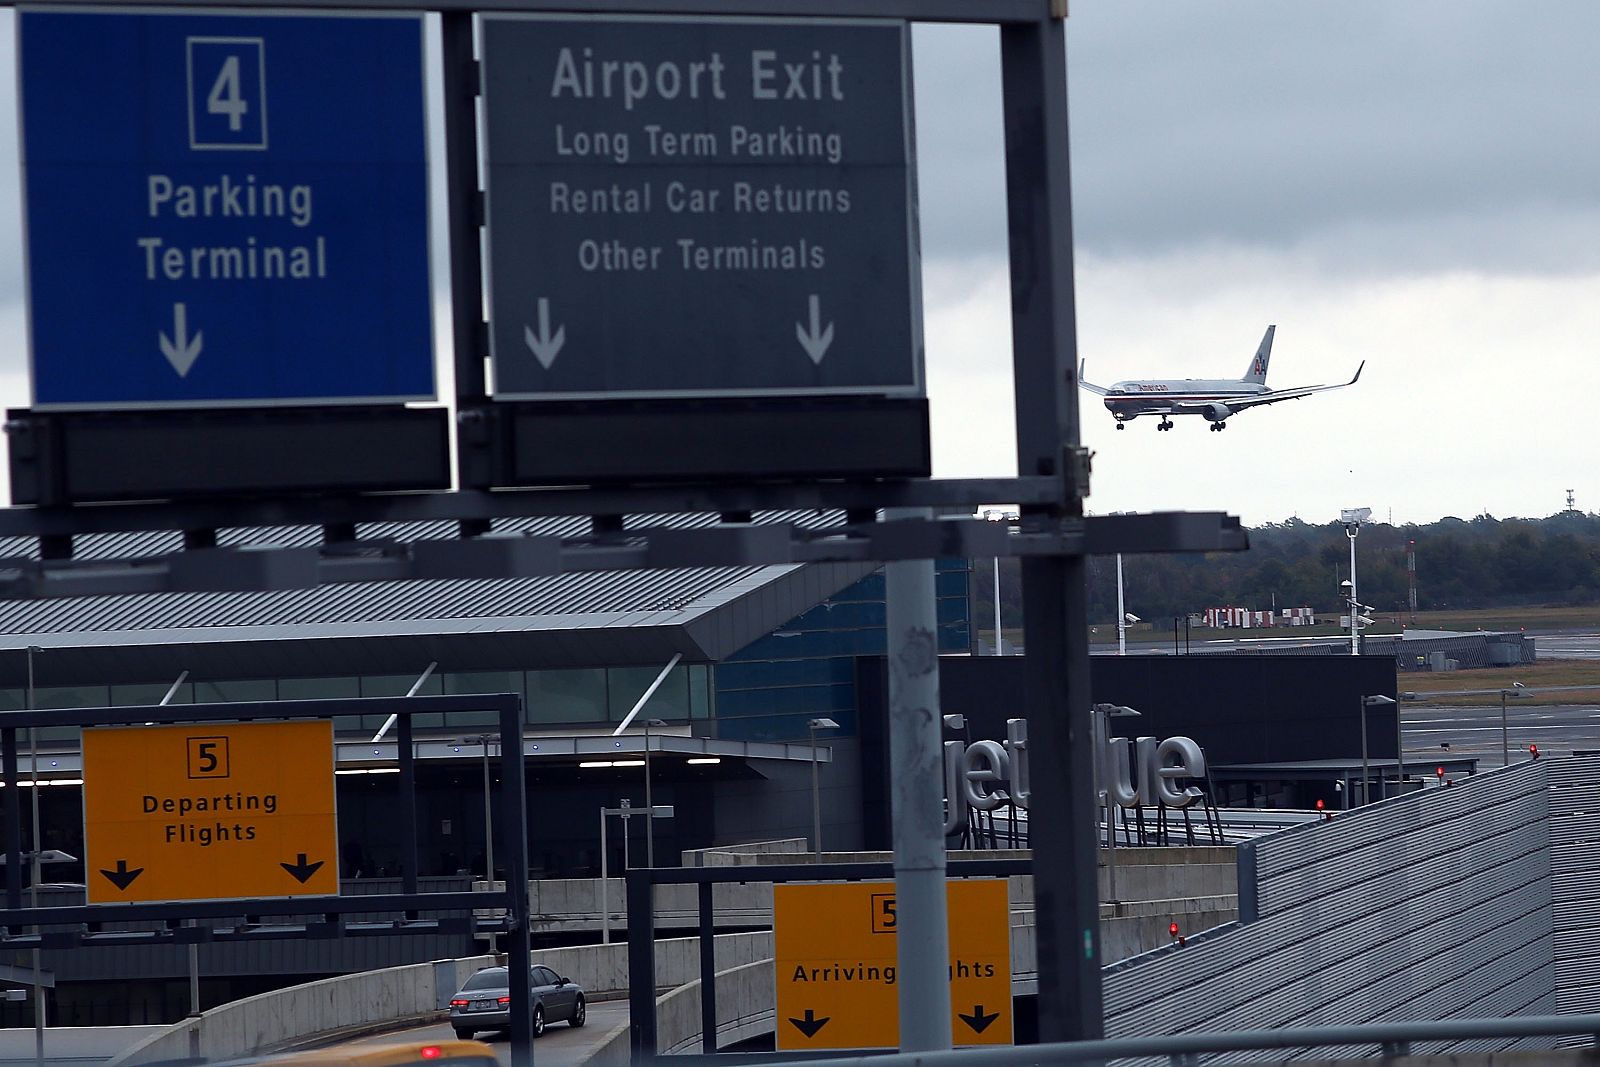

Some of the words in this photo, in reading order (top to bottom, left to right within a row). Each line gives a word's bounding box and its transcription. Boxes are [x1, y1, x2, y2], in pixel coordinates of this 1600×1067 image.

[207, 56, 248, 131] 4
[551, 48, 726, 110] Airport
[752, 50, 845, 101] Exit
[556, 124, 630, 164] Long
[644, 125, 718, 156] Term
[730, 126, 842, 164] Parking
[148, 174, 312, 227] Parking
[550, 182, 651, 213] Rental
[666, 182, 719, 213] Car
[734, 183, 851, 212] Returns
[137, 236, 326, 280] Terminal
[578, 239, 662, 271] Other
[676, 239, 826, 270] Terminals
[199, 743, 218, 772] 5
[943, 710, 1205, 836] jetlue
[143, 792, 277, 816] Departing
[165, 823, 256, 846] Flights
[882, 899, 897, 928] 5
[792, 963, 896, 985] Arriving
